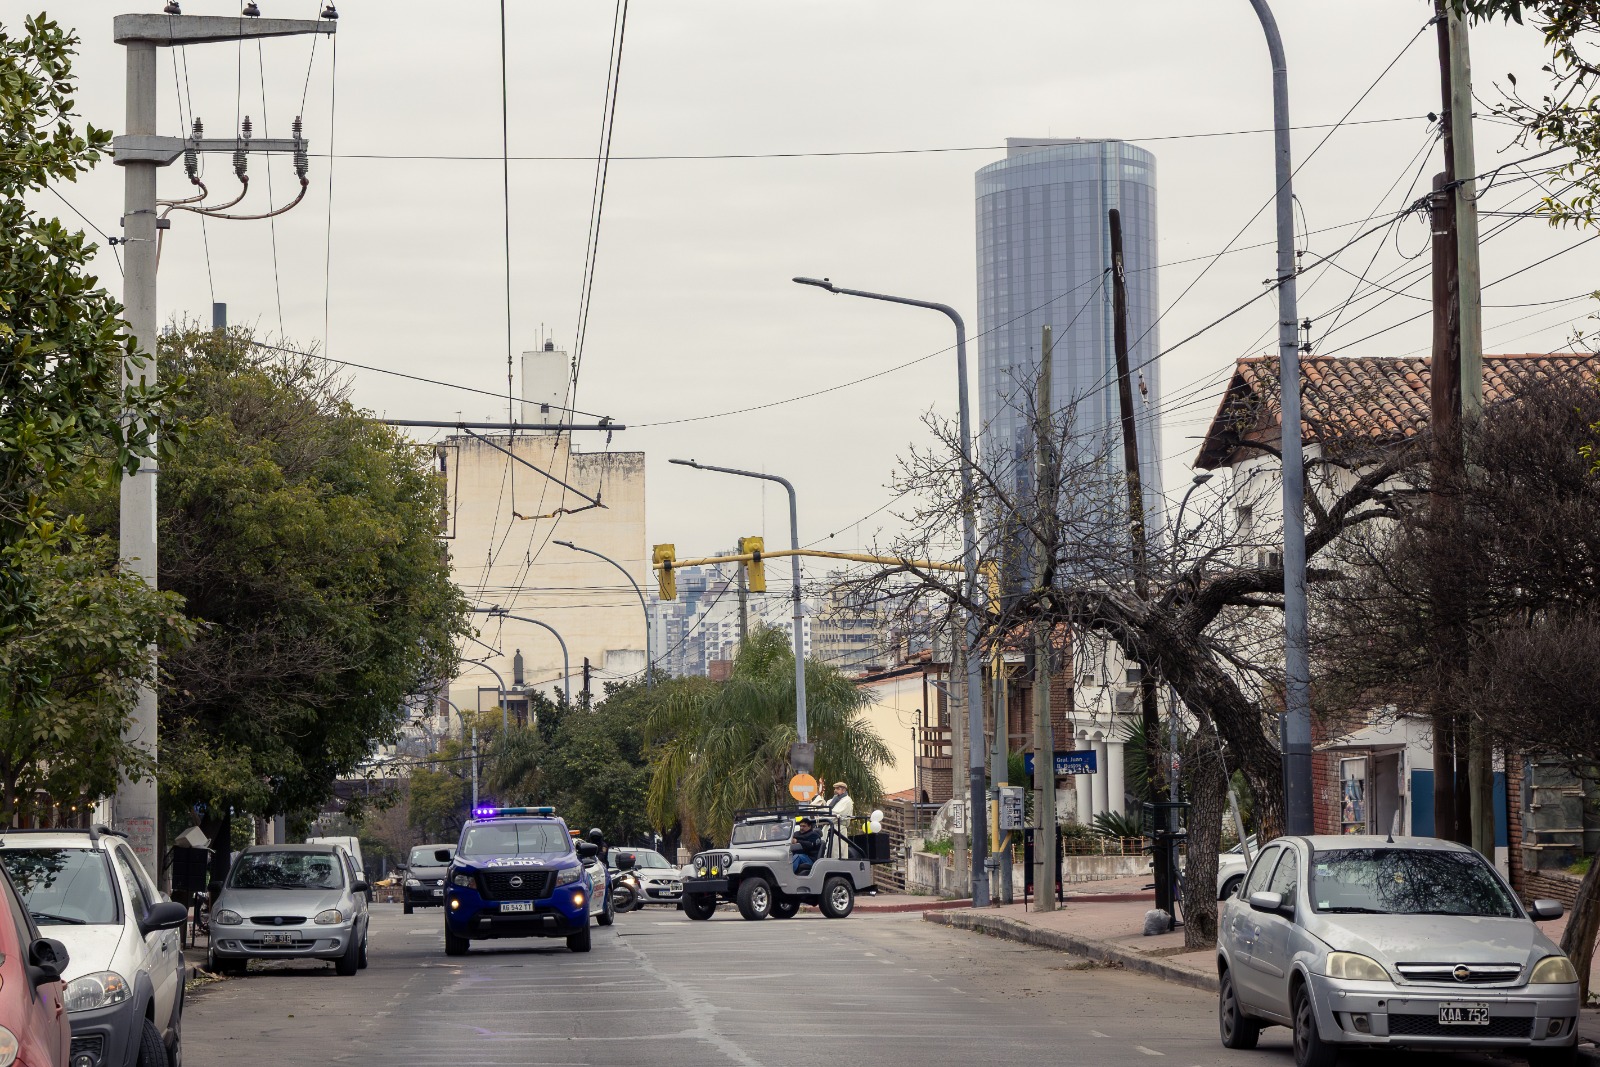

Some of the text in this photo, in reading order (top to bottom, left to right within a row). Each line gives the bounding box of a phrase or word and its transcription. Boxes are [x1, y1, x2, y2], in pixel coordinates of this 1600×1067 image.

[1013, 798, 1021, 826] FLETE
[1440, 1008, 1488, 1021] KAA 752
